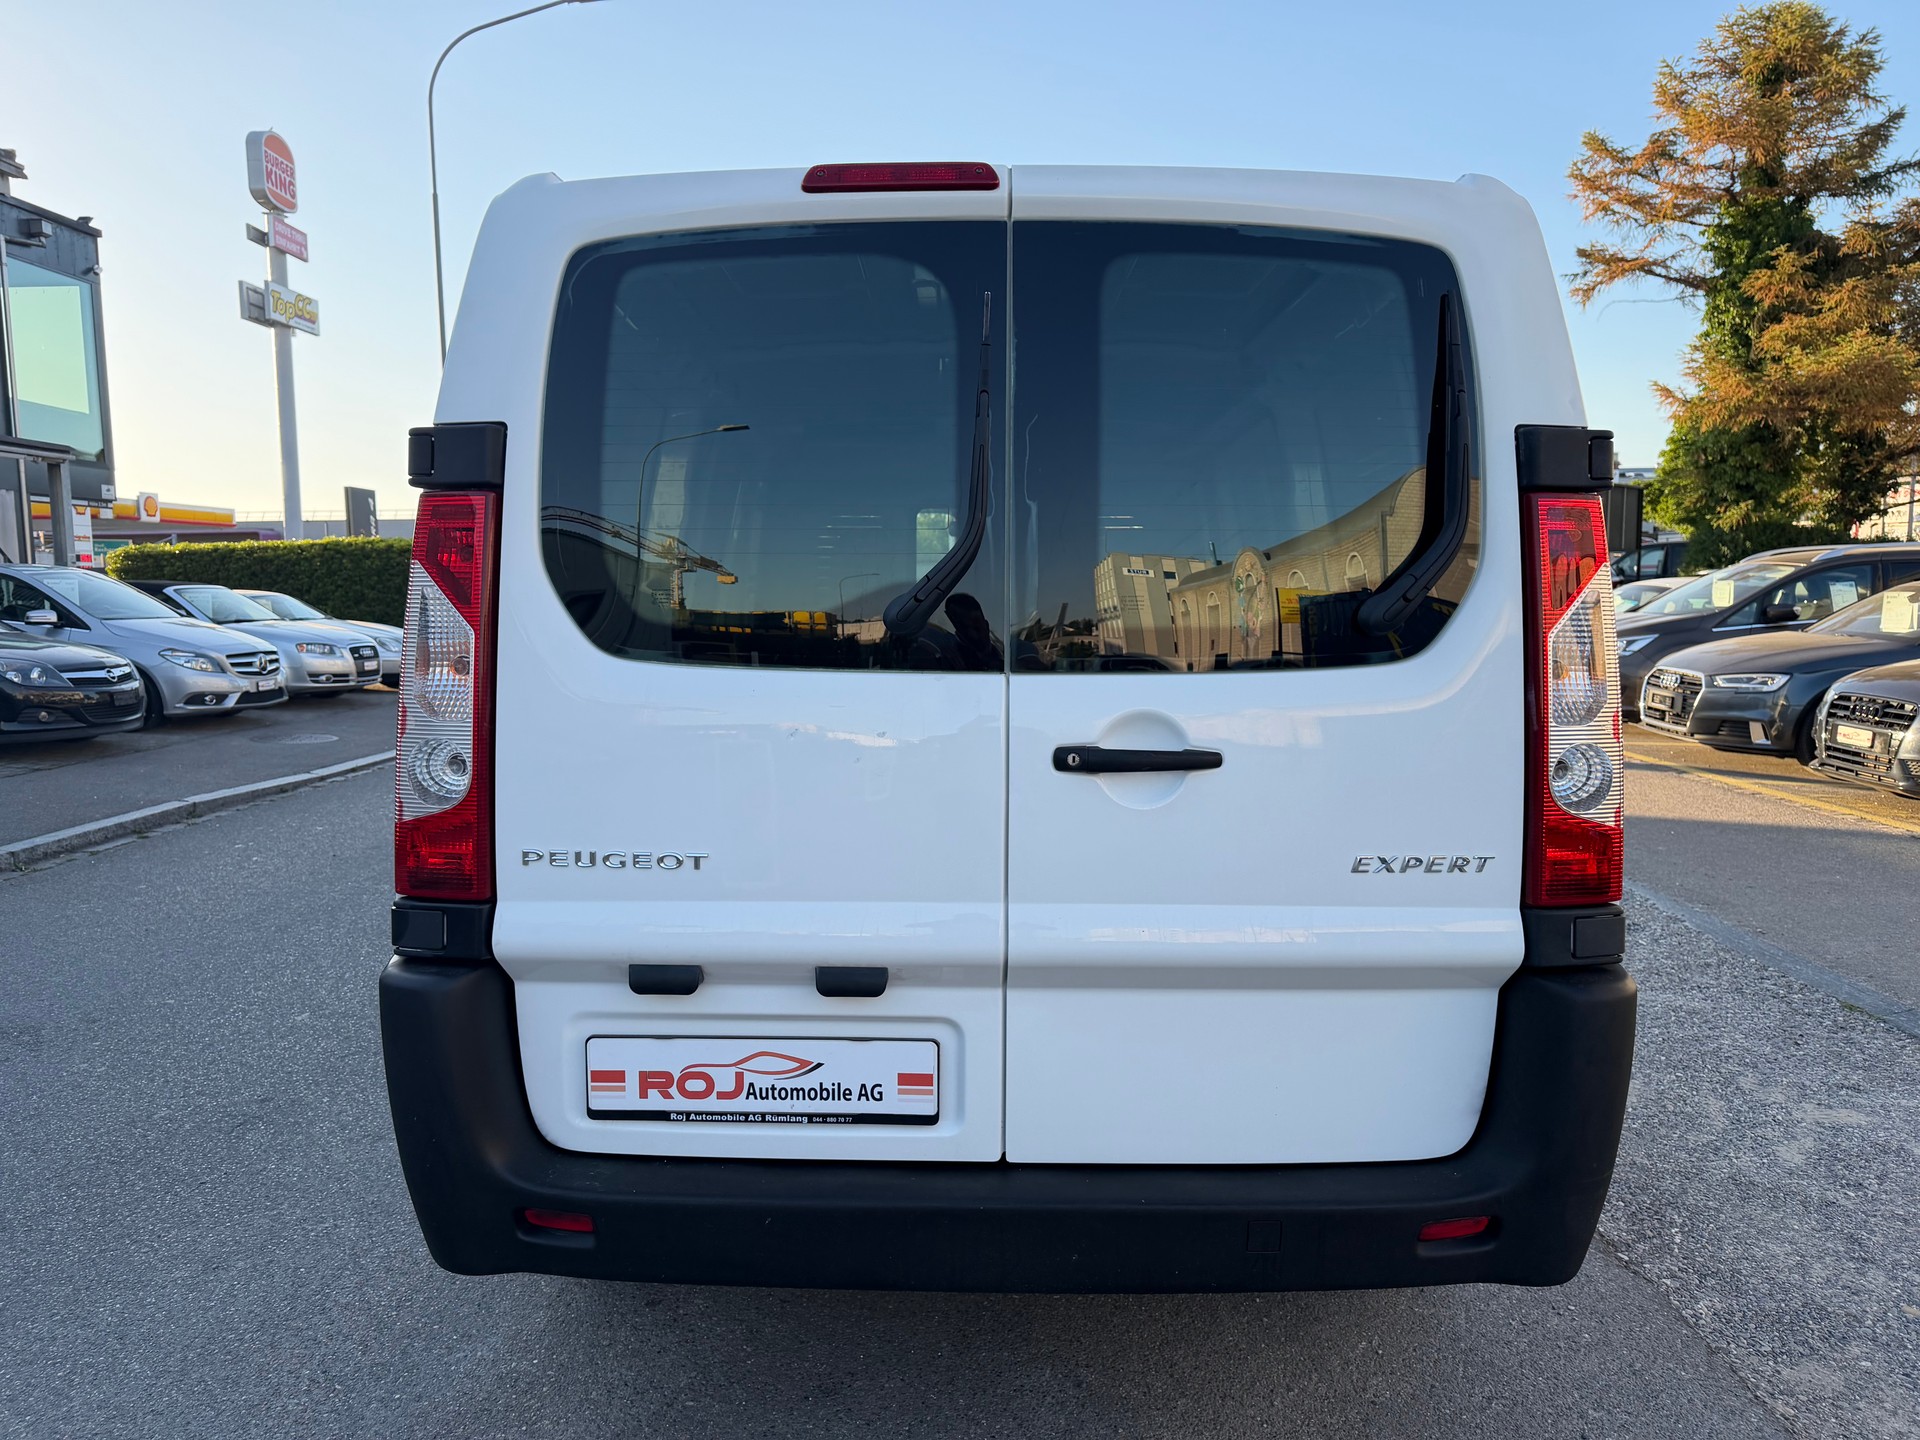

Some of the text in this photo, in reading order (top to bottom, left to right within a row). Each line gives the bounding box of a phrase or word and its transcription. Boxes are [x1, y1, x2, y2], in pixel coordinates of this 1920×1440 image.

[264, 149, 295, 180] BURGER
[265, 165, 296, 200] KING
[271, 290, 312, 323] TopCC
[521, 849, 709, 871] PEUGEOT
[1350, 855, 1496, 874] EXPERT
[638, 1070, 745, 1100] ROJ
[745, 1082, 884, 1103] Automobile AG
[670, 1112, 686, 1122] Roj
[689, 1113, 746, 1122] Automobile
[748, 1114, 762, 1122] AG
[765, 1114, 808, 1124] Rümlang
